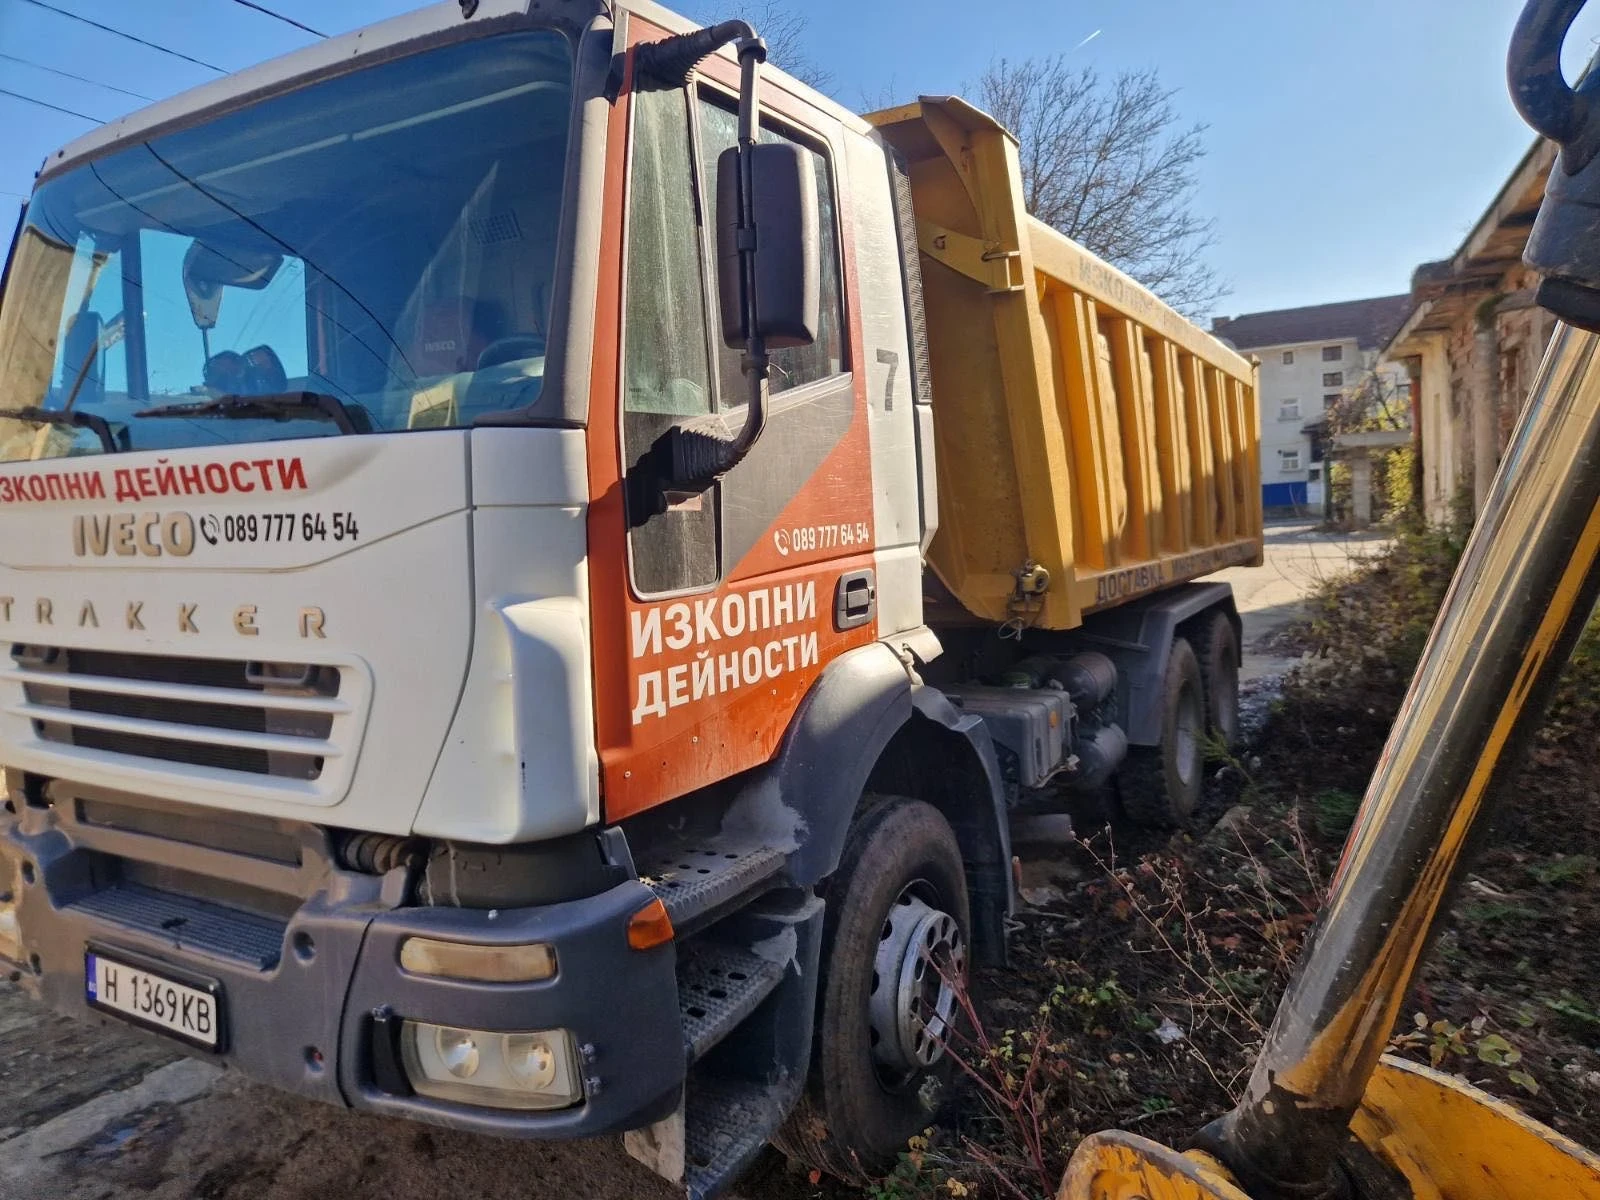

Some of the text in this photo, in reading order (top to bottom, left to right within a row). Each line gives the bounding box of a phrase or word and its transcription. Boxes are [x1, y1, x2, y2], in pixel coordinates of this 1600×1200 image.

[876, 348, 899, 411] 7
[0, 457, 308, 503] ЗКОПНИ ДЕЙНОСТИ
[73, 511, 196, 557] IVECO
[225, 512, 359, 542] 089 777 64 54
[793, 522, 869, 552] 089 777 64 54
[0, 596, 327, 639] TRAKKER
[630, 580, 816, 659] ИЗКОПНИ
[632, 631, 819, 725] ДЕЙНОСТИ
[105, 966, 118, 1003] H
